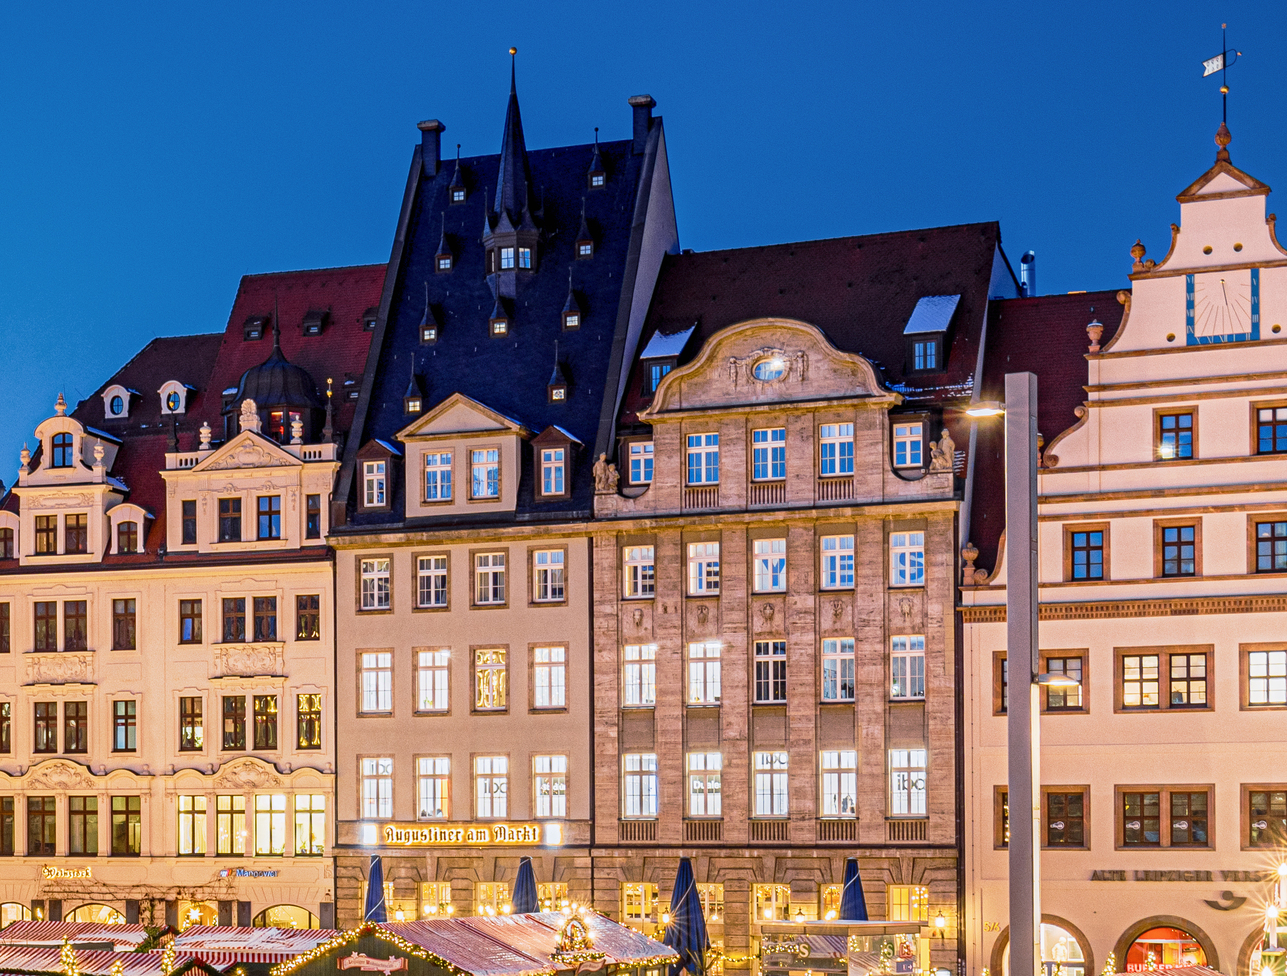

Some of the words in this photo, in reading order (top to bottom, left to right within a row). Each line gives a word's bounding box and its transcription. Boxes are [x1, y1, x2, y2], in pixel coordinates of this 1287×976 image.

[385, 826, 462, 845] Augustiner
[467, 829, 487, 842] am
[493, 825, 539, 842] Markt
[1091, 870, 1126, 882] ALTE
[1134, 870, 1213, 882] LEIPZIGER
[983, 921, 1001, 932] 5/6
